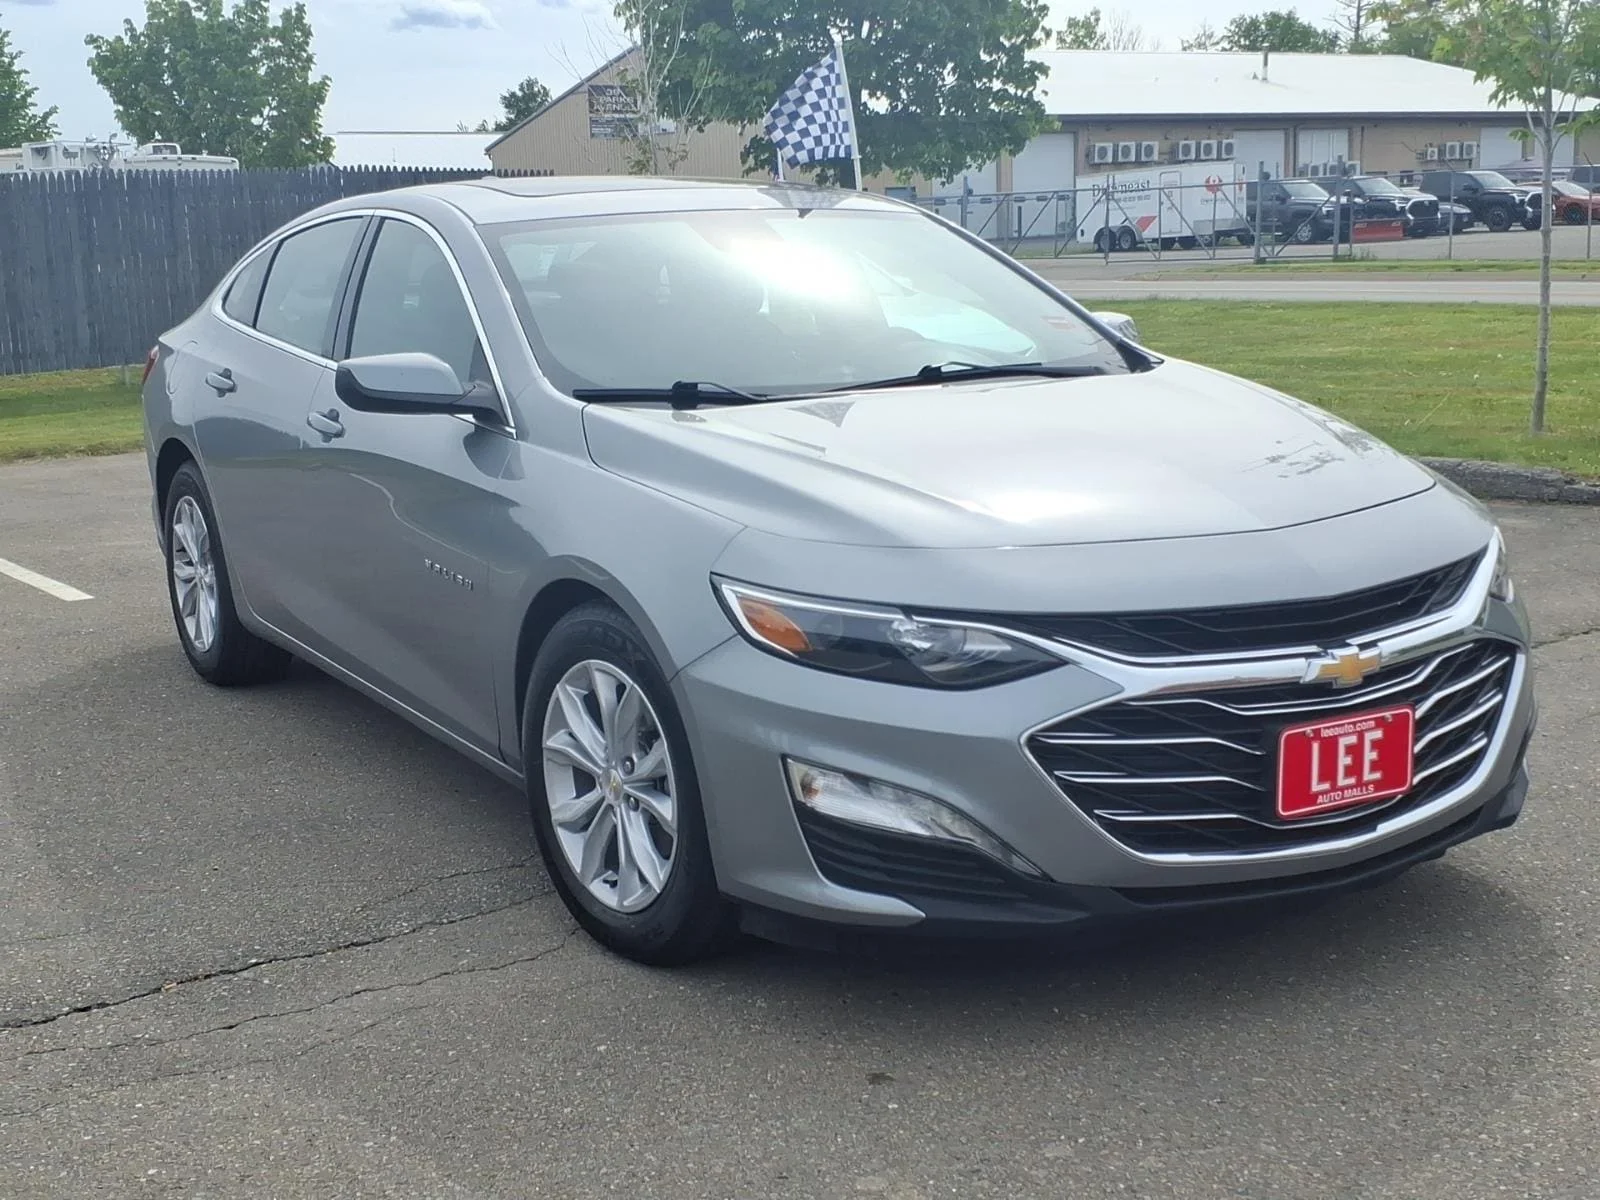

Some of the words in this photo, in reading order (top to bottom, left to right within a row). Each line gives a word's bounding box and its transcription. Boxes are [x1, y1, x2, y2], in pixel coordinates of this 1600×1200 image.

[1320, 720, 1376, 738] leeauto.com
[1310, 729, 1384, 792] LEE
[1316, 791, 1342, 804] AUTO
[1343, 784, 1374, 799] MALLS
